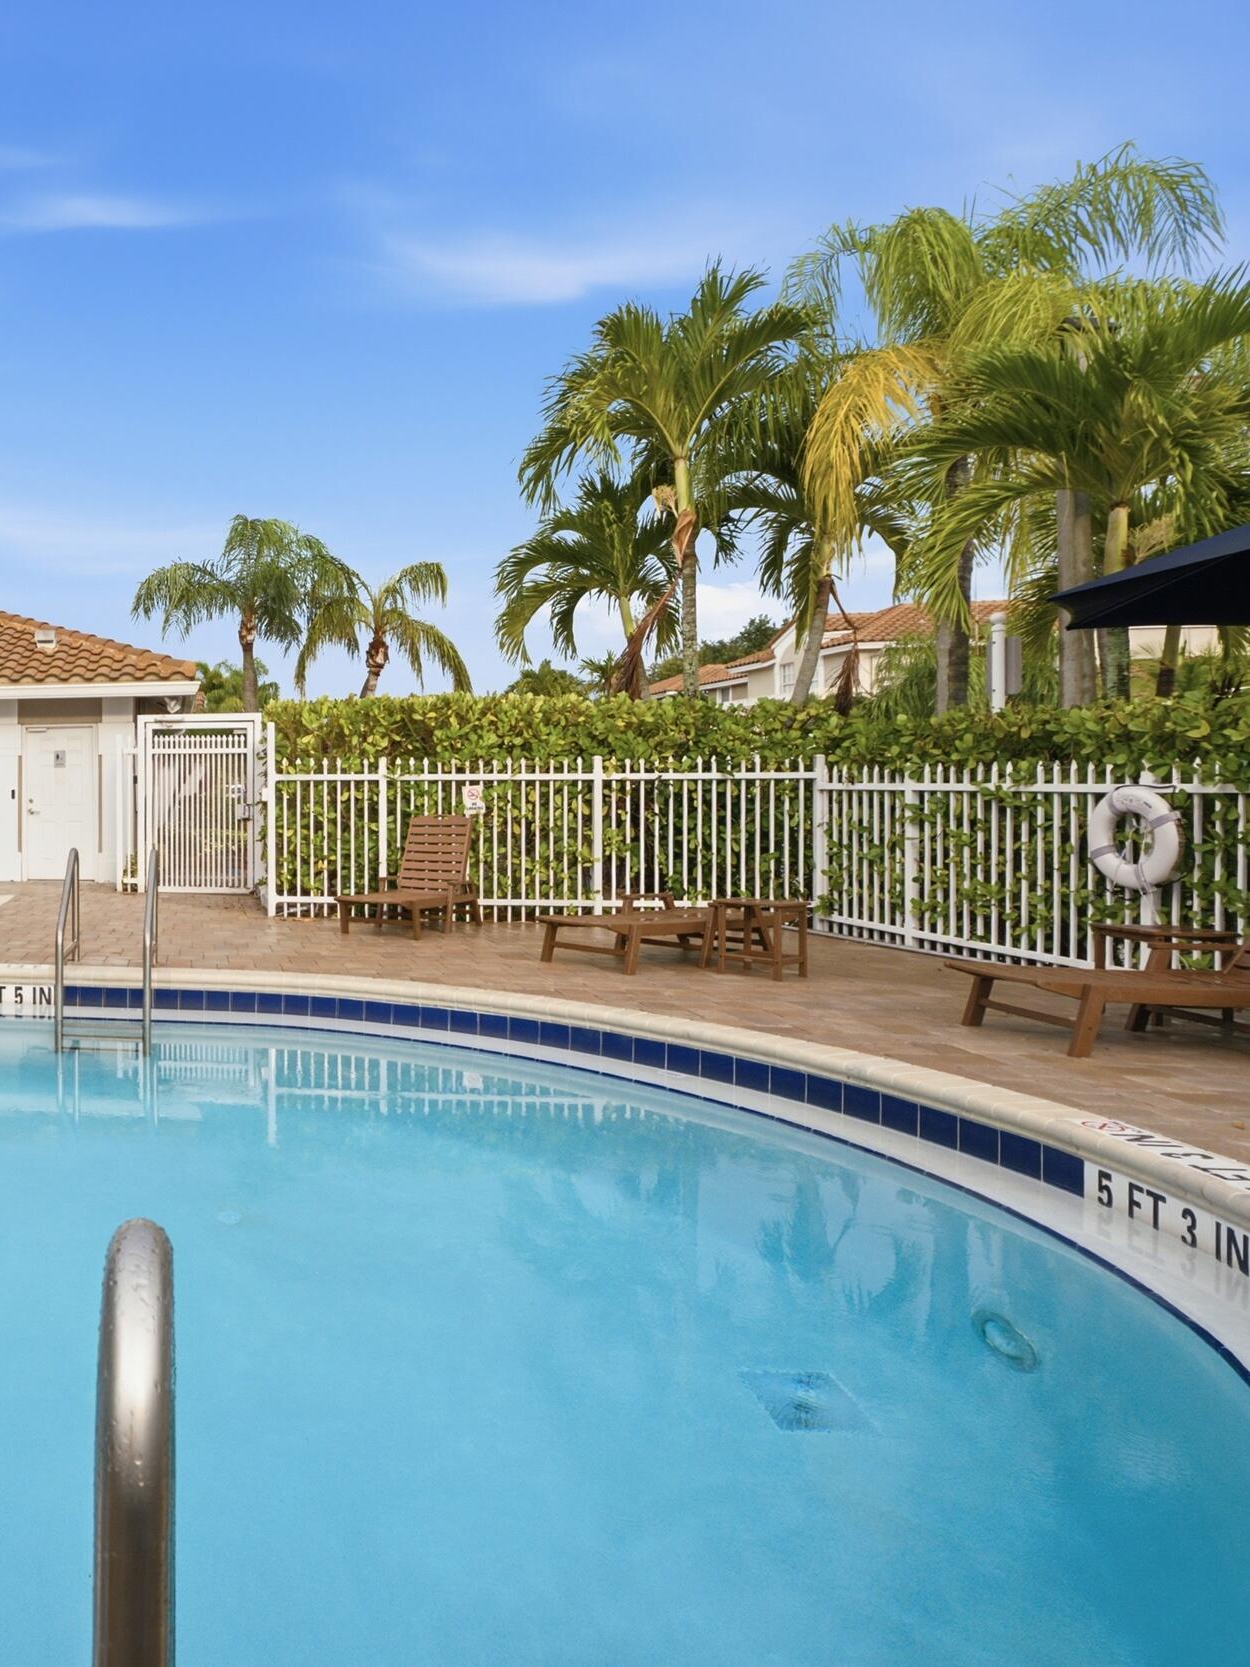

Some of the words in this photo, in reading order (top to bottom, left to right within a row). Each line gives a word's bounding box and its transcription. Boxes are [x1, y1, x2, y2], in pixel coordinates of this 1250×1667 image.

[14, 986, 23, 1004] 5
[32, 987, 52, 1005] IN
[1097, 1169, 1113, 1208] 5
[1128, 1182, 1166, 1231] FT
[1181, 1207, 1197, 1248] 3
[1215, 1221, 1250, 1276] IN
